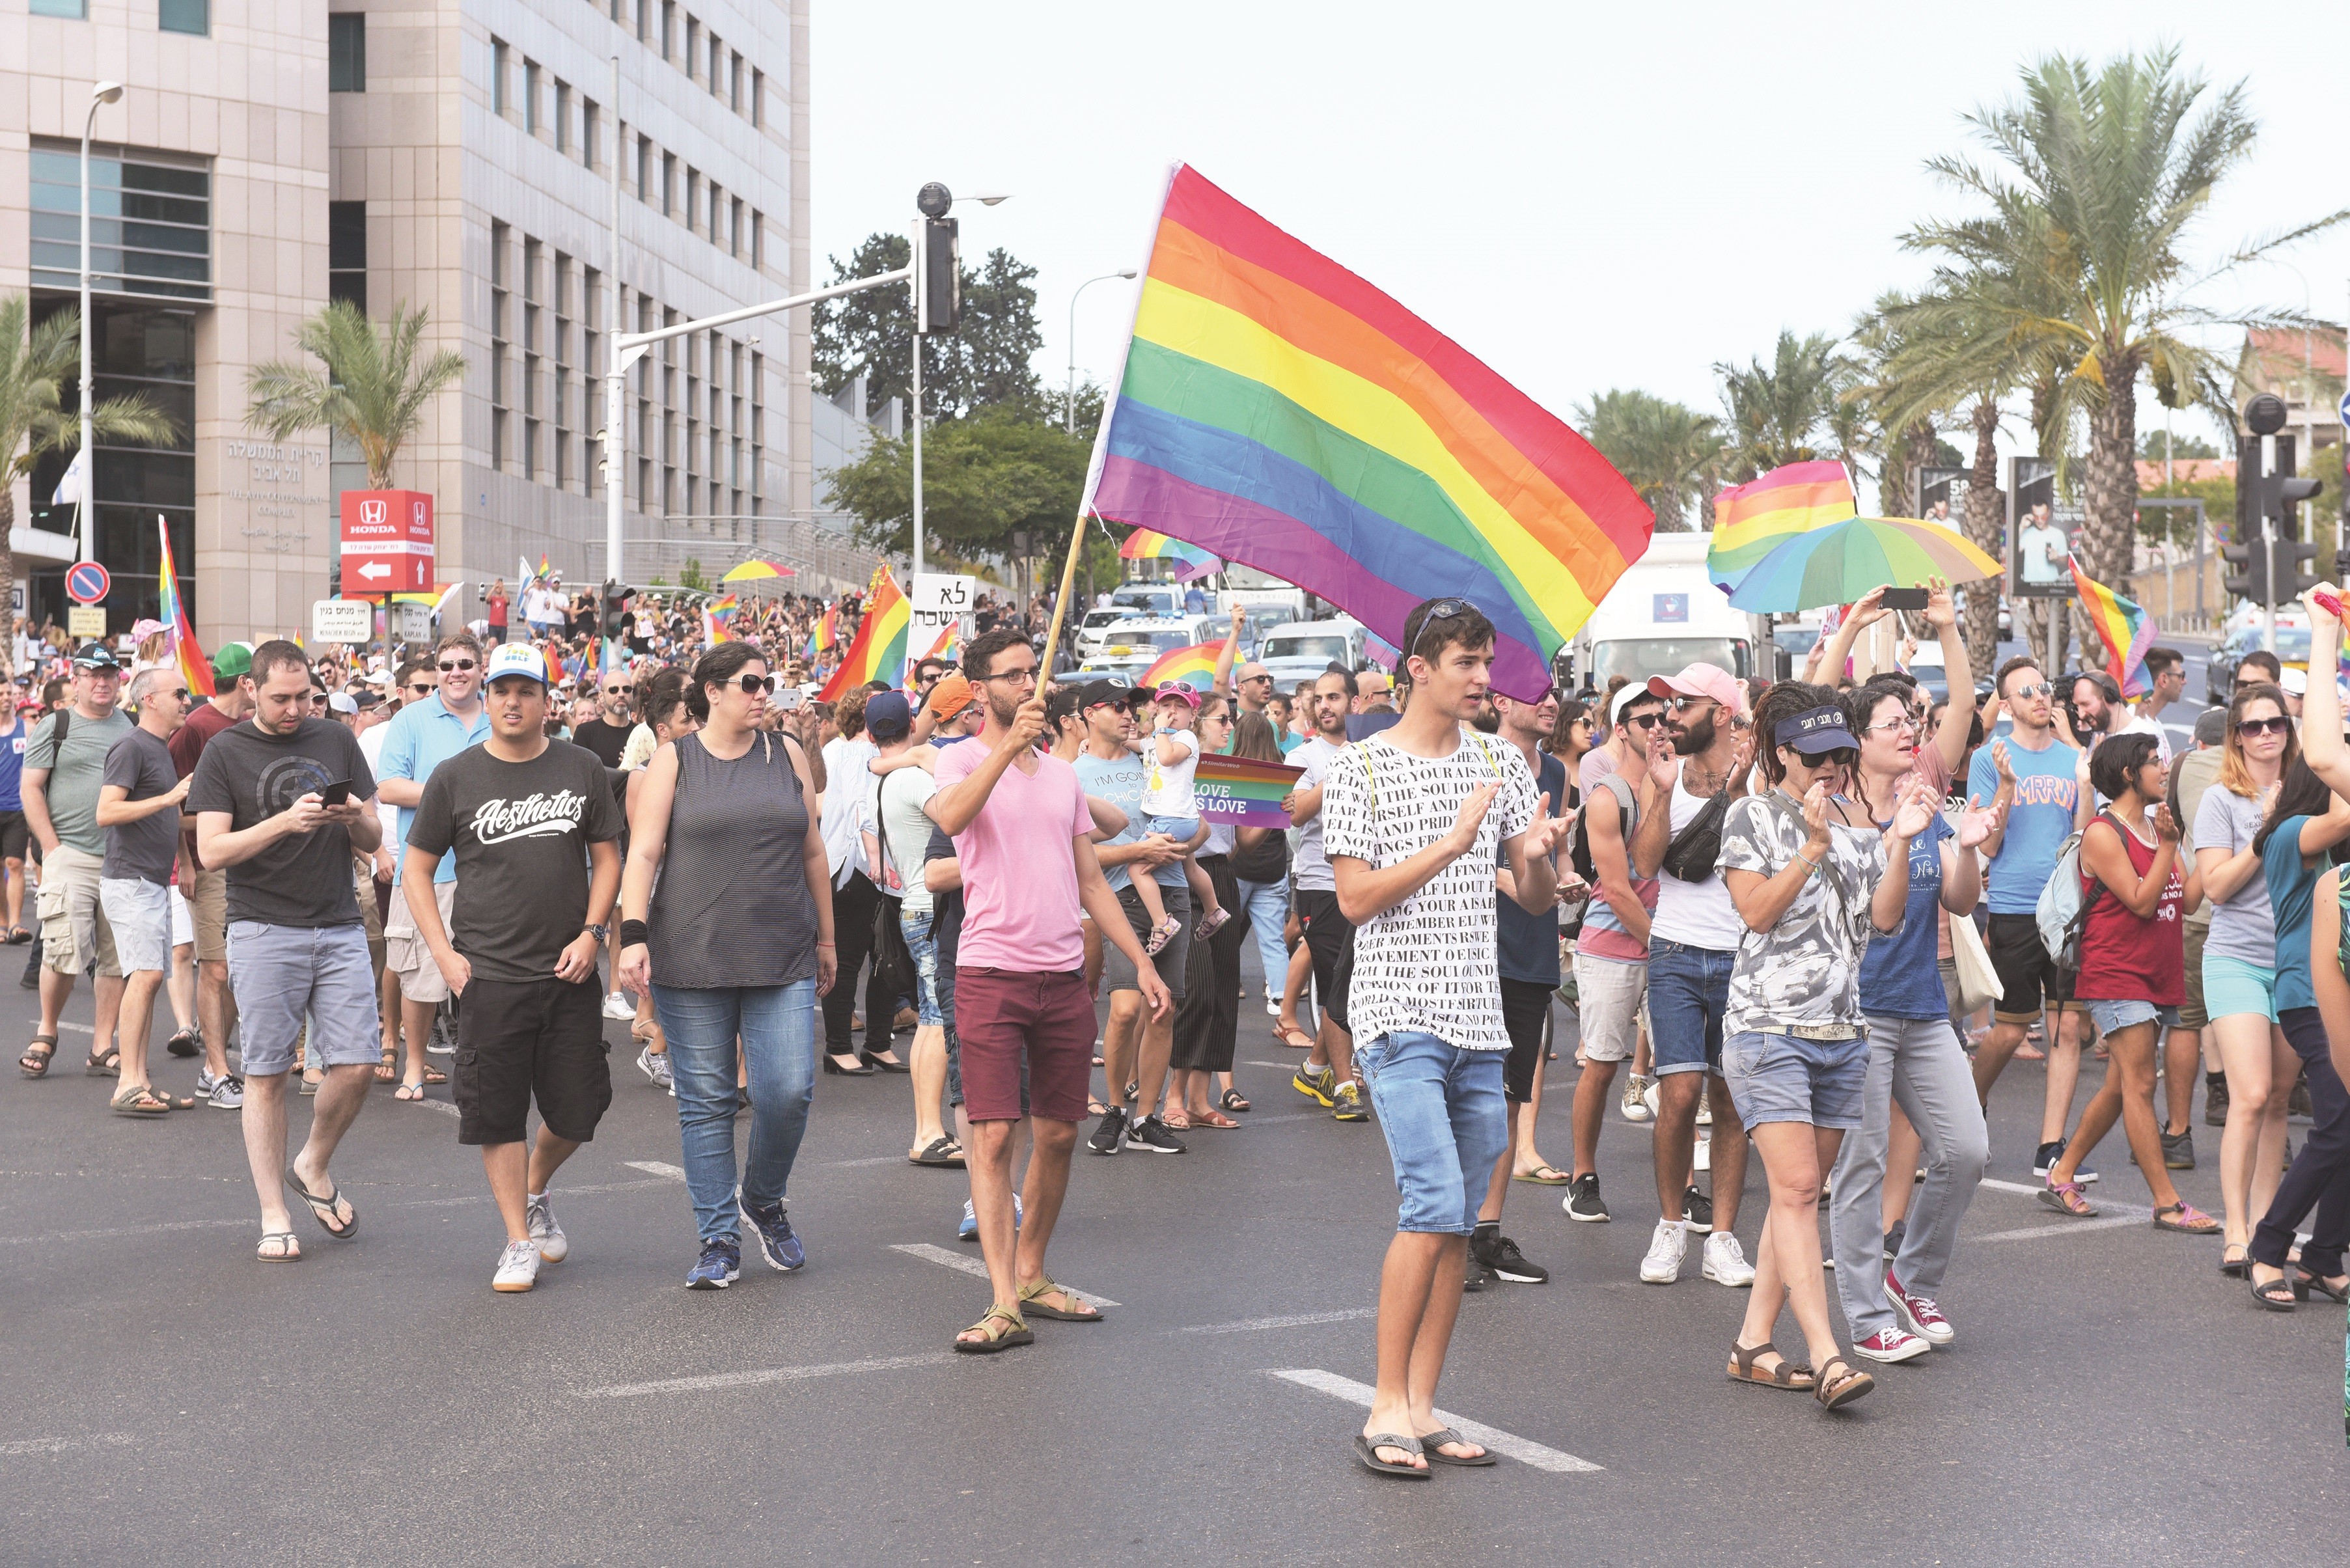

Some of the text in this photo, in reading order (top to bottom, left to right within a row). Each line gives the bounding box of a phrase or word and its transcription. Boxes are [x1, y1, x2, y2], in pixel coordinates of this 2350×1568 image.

[229, 439, 284, 461] הממשלה
[254, 464, 300, 483] תל אביב
[350, 525, 397, 534] HONDA
[409, 526, 430, 536] HONDA
[941, 581, 965, 605] לא
[1207, 760, 1240, 769] SimilarWeb
[1094, 774, 1114, 787] I'M
[1409, 767, 1452, 782] YOUR
[1193, 782, 1231, 798] LOVE
[1383, 787, 1418, 805] THE
[469, 789, 587, 836] Aesthetics
[1208, 798, 1247, 814] LOVE
[1429, 798, 1458, 813] AND
[1381, 821, 1415, 838] AND
[2168, 890, 2178, 899] NO
[1418, 899, 1456, 913] YOUR
[1380, 916, 1456, 933] REMEMBER
[1387, 931, 1458, 946] MOMENTS
[1383, 965, 1416, 979] THE
[1418, 982, 1440, 995] OF
[1351, 993, 1389, 1011] WORLD
